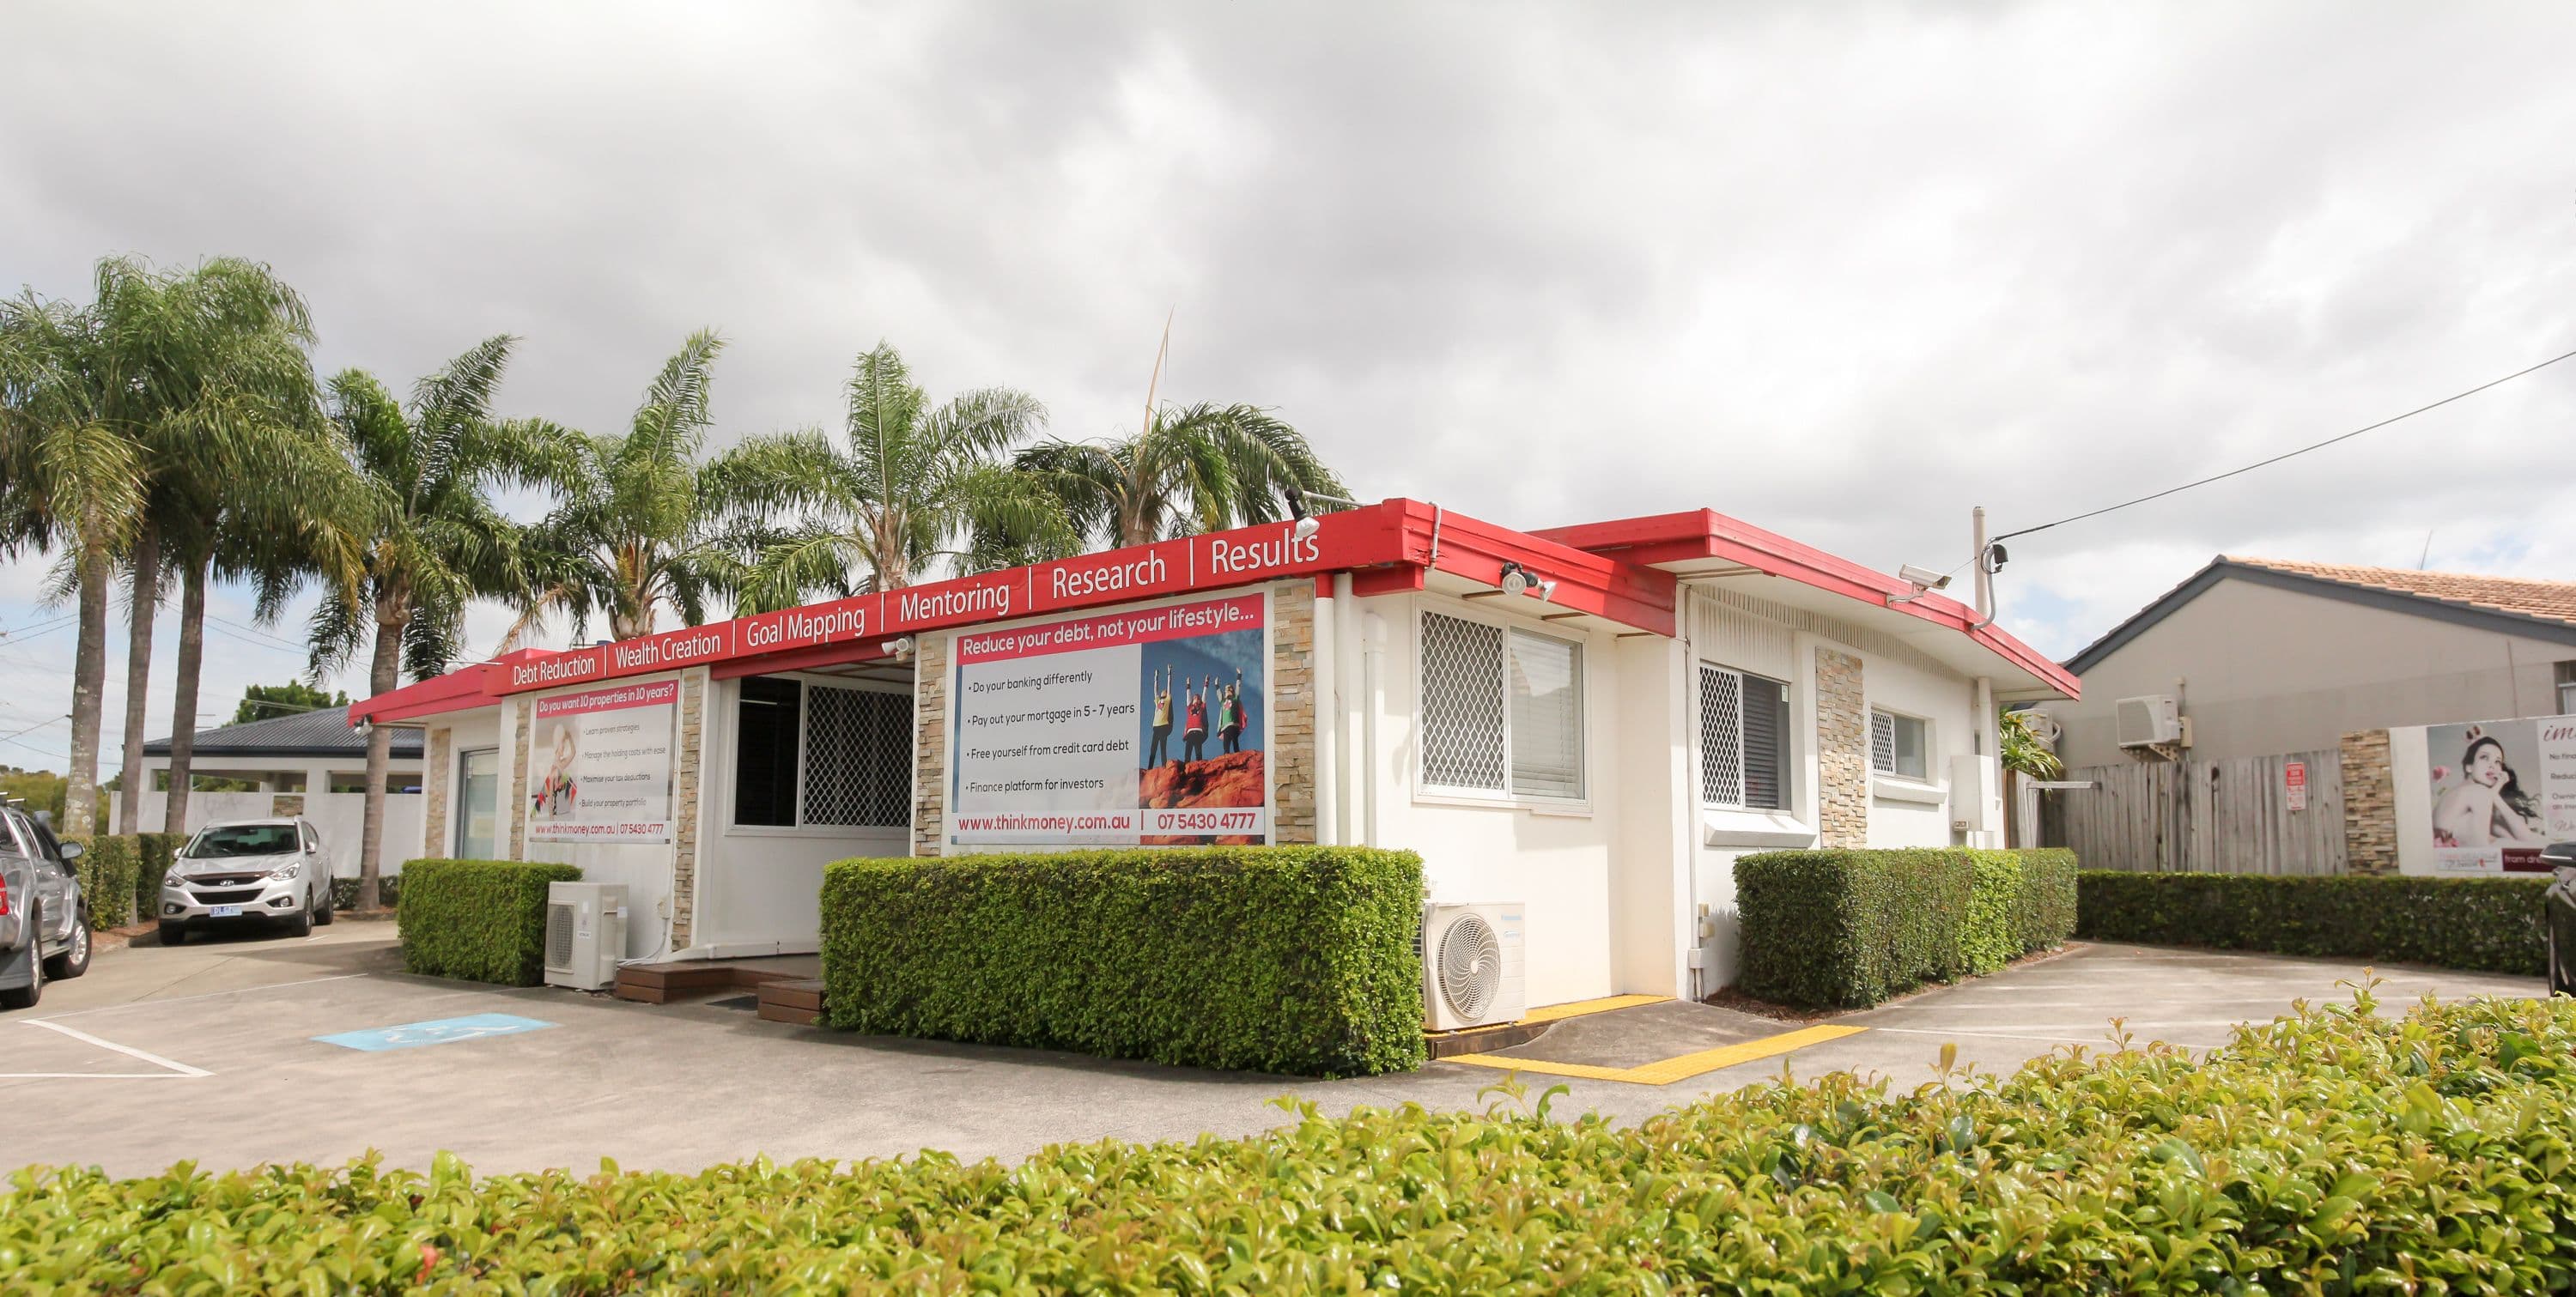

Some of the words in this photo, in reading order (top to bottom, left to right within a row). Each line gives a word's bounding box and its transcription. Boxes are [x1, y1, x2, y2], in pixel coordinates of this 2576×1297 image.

[513, 664, 538, 686] Debt
[540, 655, 595, 679] Reduction
[616, 645, 659, 669] Wealth
[662, 633, 720, 661] Creation
[747, 615, 783, 646] Goal
[787, 608, 865, 643] Mapping
[900, 582, 1010, 622] Mentoring
[1053, 550, 1165, 599] Research
[1212, 528, 1320, 574] Results
[963, 637, 1014, 656] Reduce
[1018, 632, 1052, 652] your
[1054, 623, 1094, 644] debt,
[1097, 619, 1124, 639] not
[1127, 615, 1166, 639] your
[1169, 603, 1254, 629] lifestyle...
[973, 682, 985, 693] Do
[986, 682, 1005, 694] your
[1007, 676, 1042, 690] banking
[1043, 670, 1093, 685] differently
[539, 701, 549, 712] Do
[549, 701, 561, 714] you
[562, 698, 580, 710] want
[580, 694, 589, 707] 10
[589, 692, 627, 709] properties
[628, 690, 635, 701] in
[635, 688, 645, 700] 10
[646, 683, 674, 702] years?
[972, 715, 988, 728] Pay
[989, 713, 1004, 724] out
[1005, 712, 1025, 726] your
[1027, 709, 1072, 724] mortgage
[1073, 707, 1082, 718] in
[1084, 706, 1091, 717] 5
[1098, 704, 1105, 716] 7
[1107, 704, 1135, 718] years
[599, 726, 616, 735] proven
[617, 723, 640, 734] strategies
[2543, 724, 2576, 742] im
[585, 751, 602, 761] Manage
[603, 749, 611, 758] the
[611, 748, 628, 760] holding
[641, 746, 653, 755] with
[971, 749, 991, 760] Free
[992, 745, 1028, 761] yourself
[1030, 744, 1051, 756] from
[1053, 742, 1080, 755] credit
[1082, 741, 1104, 753] card
[1106, 739, 1129, 752] debt
[970, 782, 1003, 793] Finance
[1005, 779, 1043, 794] platform
[1045, 779, 1059, 791] for
[1060, 778, 1104, 790] investors
[593, 800, 604, 809] your
[605, 800, 625, 809] property
[626, 797, 647, 808] portfolio
[535, 822, 616, 836] www.thinkmoney.com.au
[620, 823, 629, 834] 07
[629, 823, 647, 834] 5430
[647, 823, 665, 834] 4777
[958, 814, 1131, 834] www.thinkmoney.com.au
[1157, 814, 1176, 831] 07
[1178, 812, 1217, 830] 5430
[1220, 812, 1256, 829] 4777
